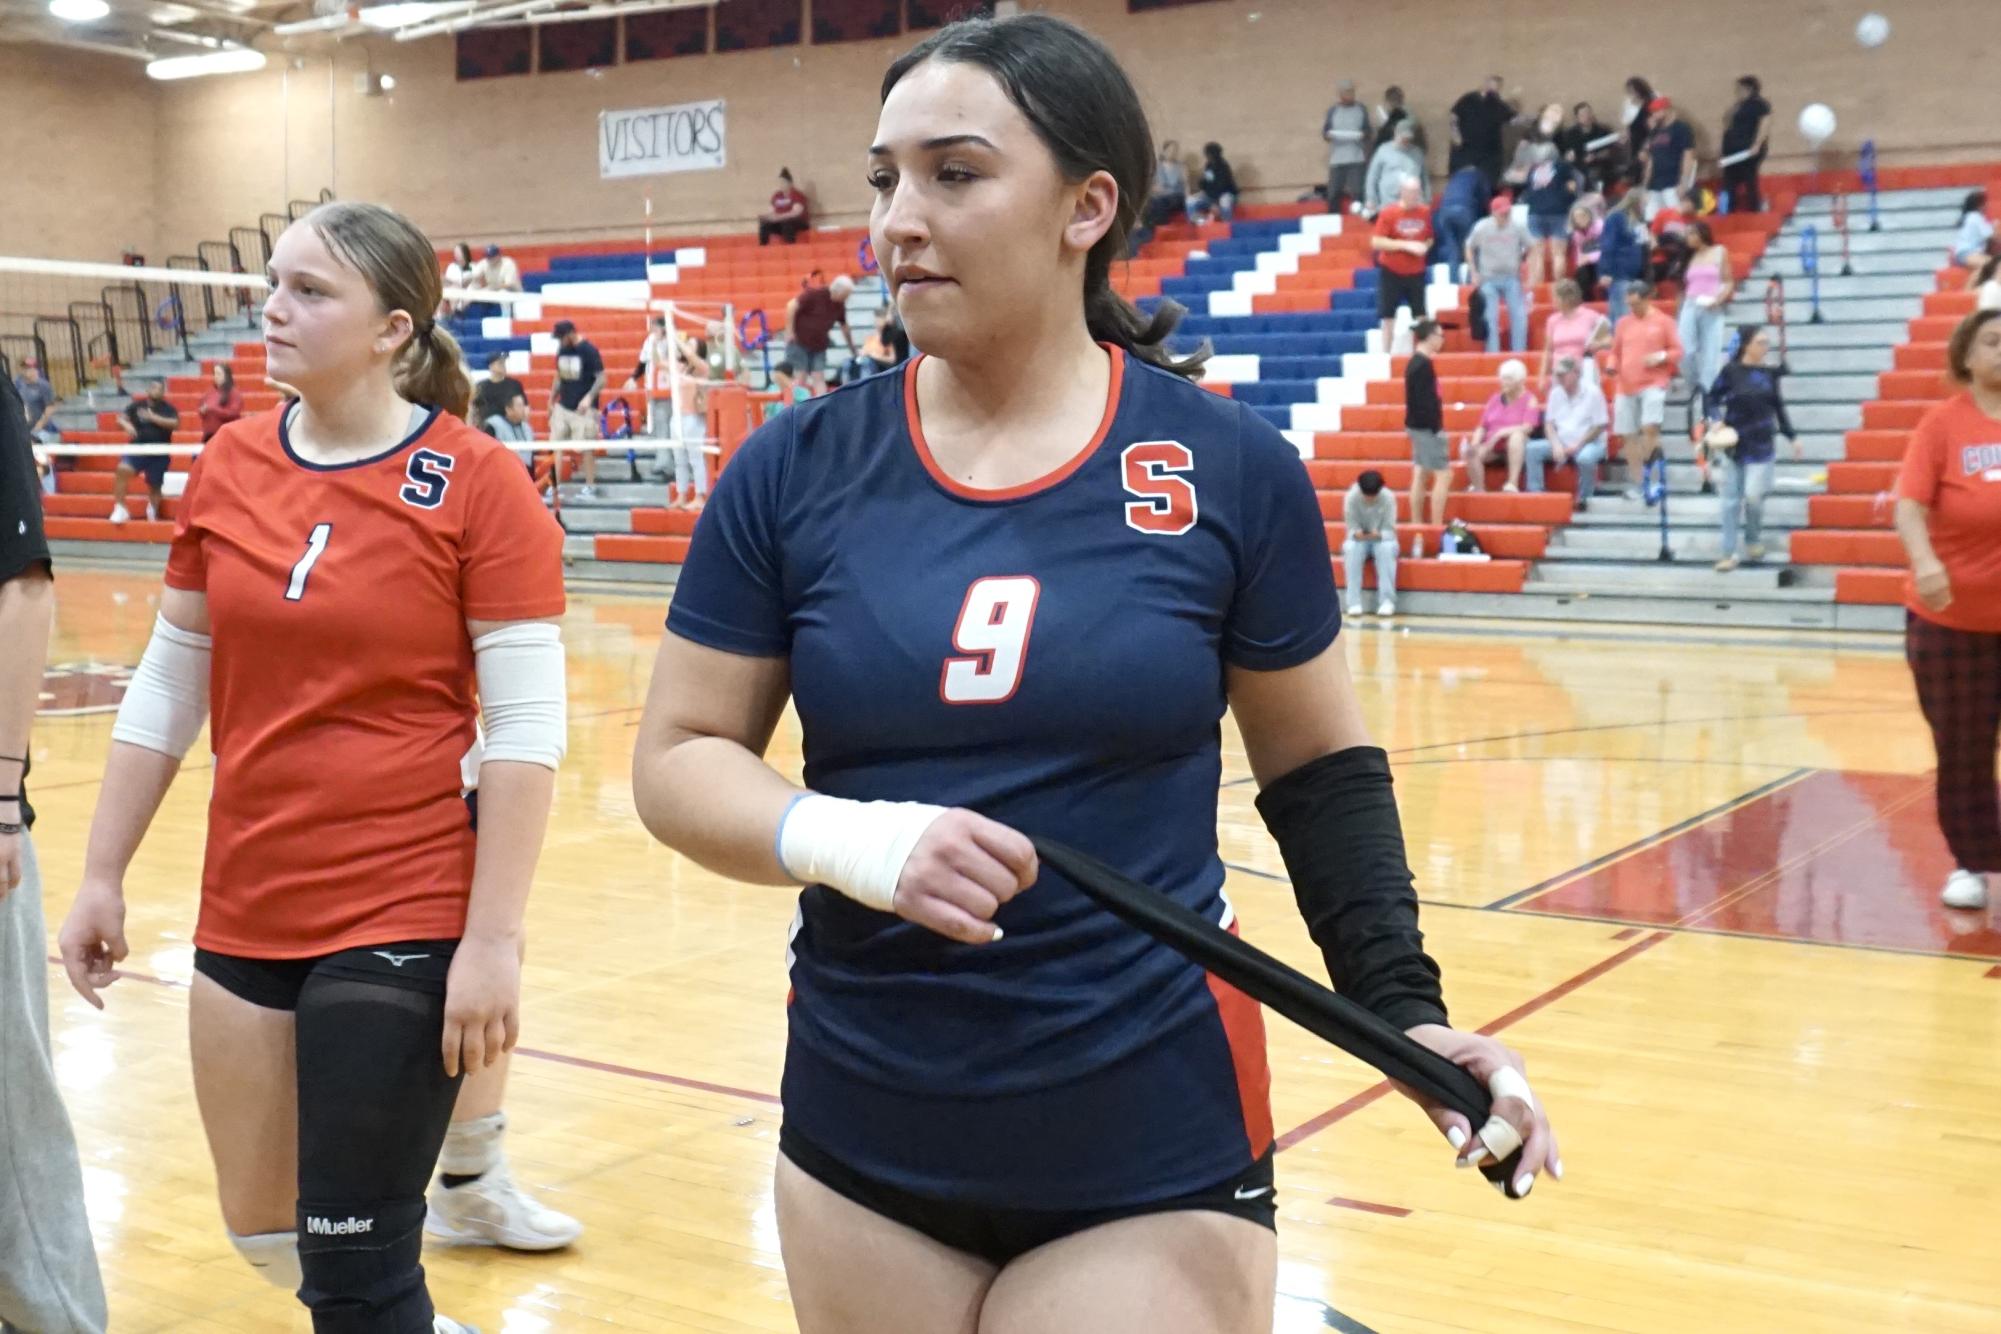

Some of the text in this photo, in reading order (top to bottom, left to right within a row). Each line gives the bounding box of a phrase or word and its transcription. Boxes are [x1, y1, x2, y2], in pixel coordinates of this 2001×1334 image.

[604, 104, 722, 162] VISITORS
[399, 447, 455, 510] S
[1121, 440, 1198, 536] S
[284, 522, 333, 601] 1
[939, 574, 1041, 705] 9
[307, 1216, 374, 1235] Mueller
